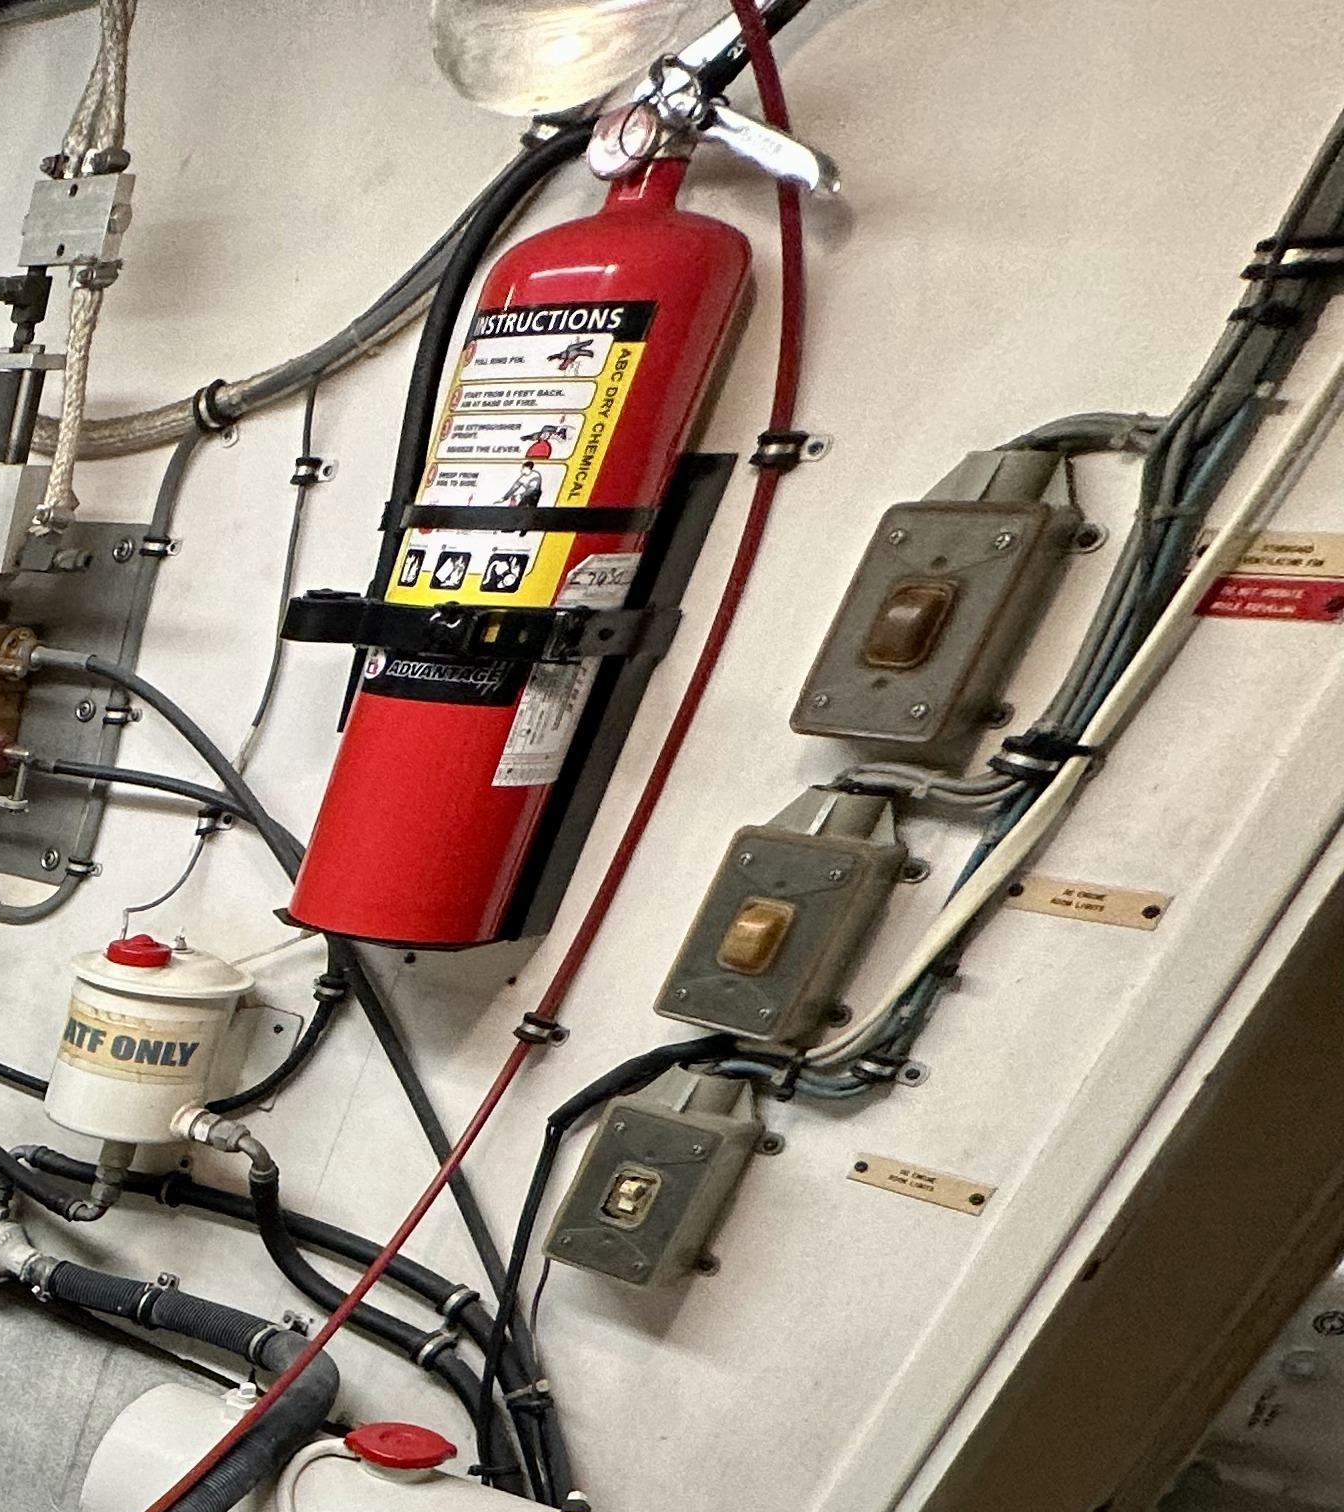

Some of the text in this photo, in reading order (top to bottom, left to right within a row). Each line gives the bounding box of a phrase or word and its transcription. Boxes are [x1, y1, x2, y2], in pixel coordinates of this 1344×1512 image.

[475, 307, 625, 335] INSTRUCTIONS
[567, 348, 631, 501] ABC DRY CHEMICAL
[387, 660, 503, 684] ADVANTAGE
[63, 1016, 200, 1067] ATF ONLY
